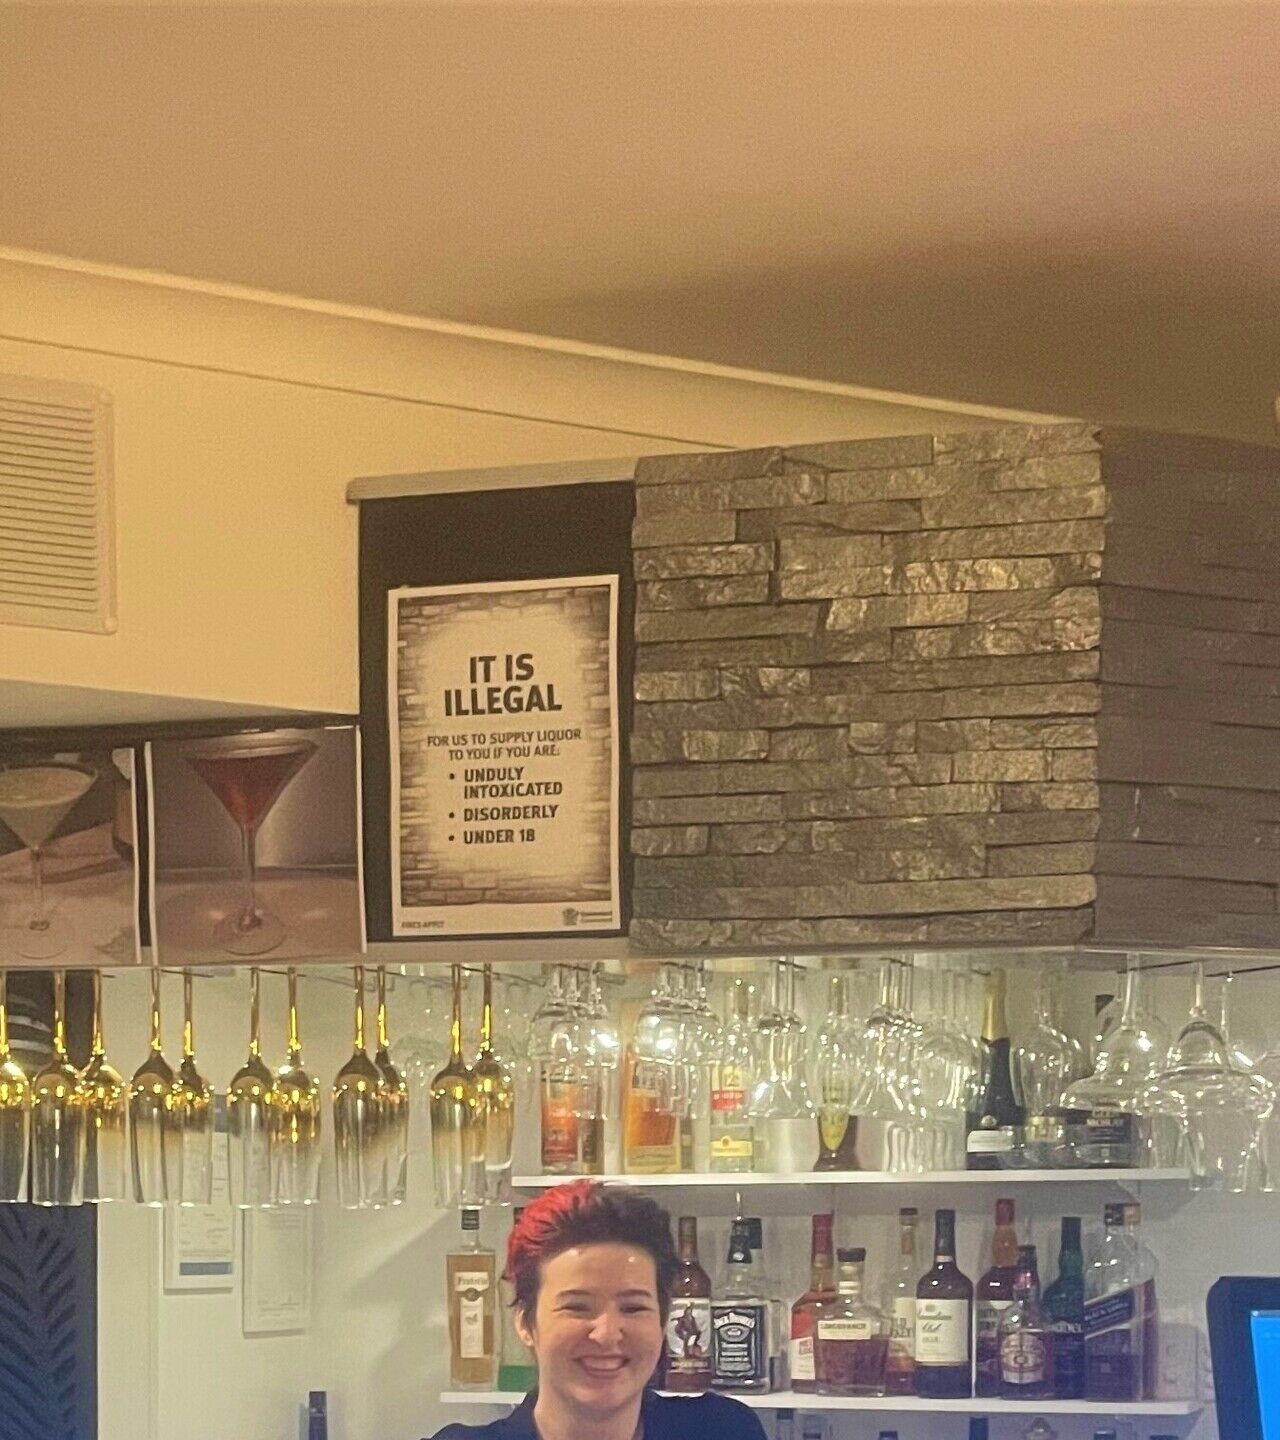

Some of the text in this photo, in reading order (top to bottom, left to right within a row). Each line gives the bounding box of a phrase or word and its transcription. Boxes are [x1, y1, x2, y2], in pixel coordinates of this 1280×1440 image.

[470, 652, 535, 684] IT IS
[444, 683, 563, 717] ILLEGAL
[427, 728, 582, 747] FOR US TO SUPPLY LIQUOR
[448, 749, 464, 761] TO
[466, 748, 491, 760] YOU
[493, 747, 505, 759] IF
[506, 746, 531, 758] YOU
[464, 766, 524, 783] UNDULY
[464, 782, 563, 799] INTOXICATED
[464, 804, 560, 822] DISORDERLY
[463, 828, 535, 845] UNDER 18
